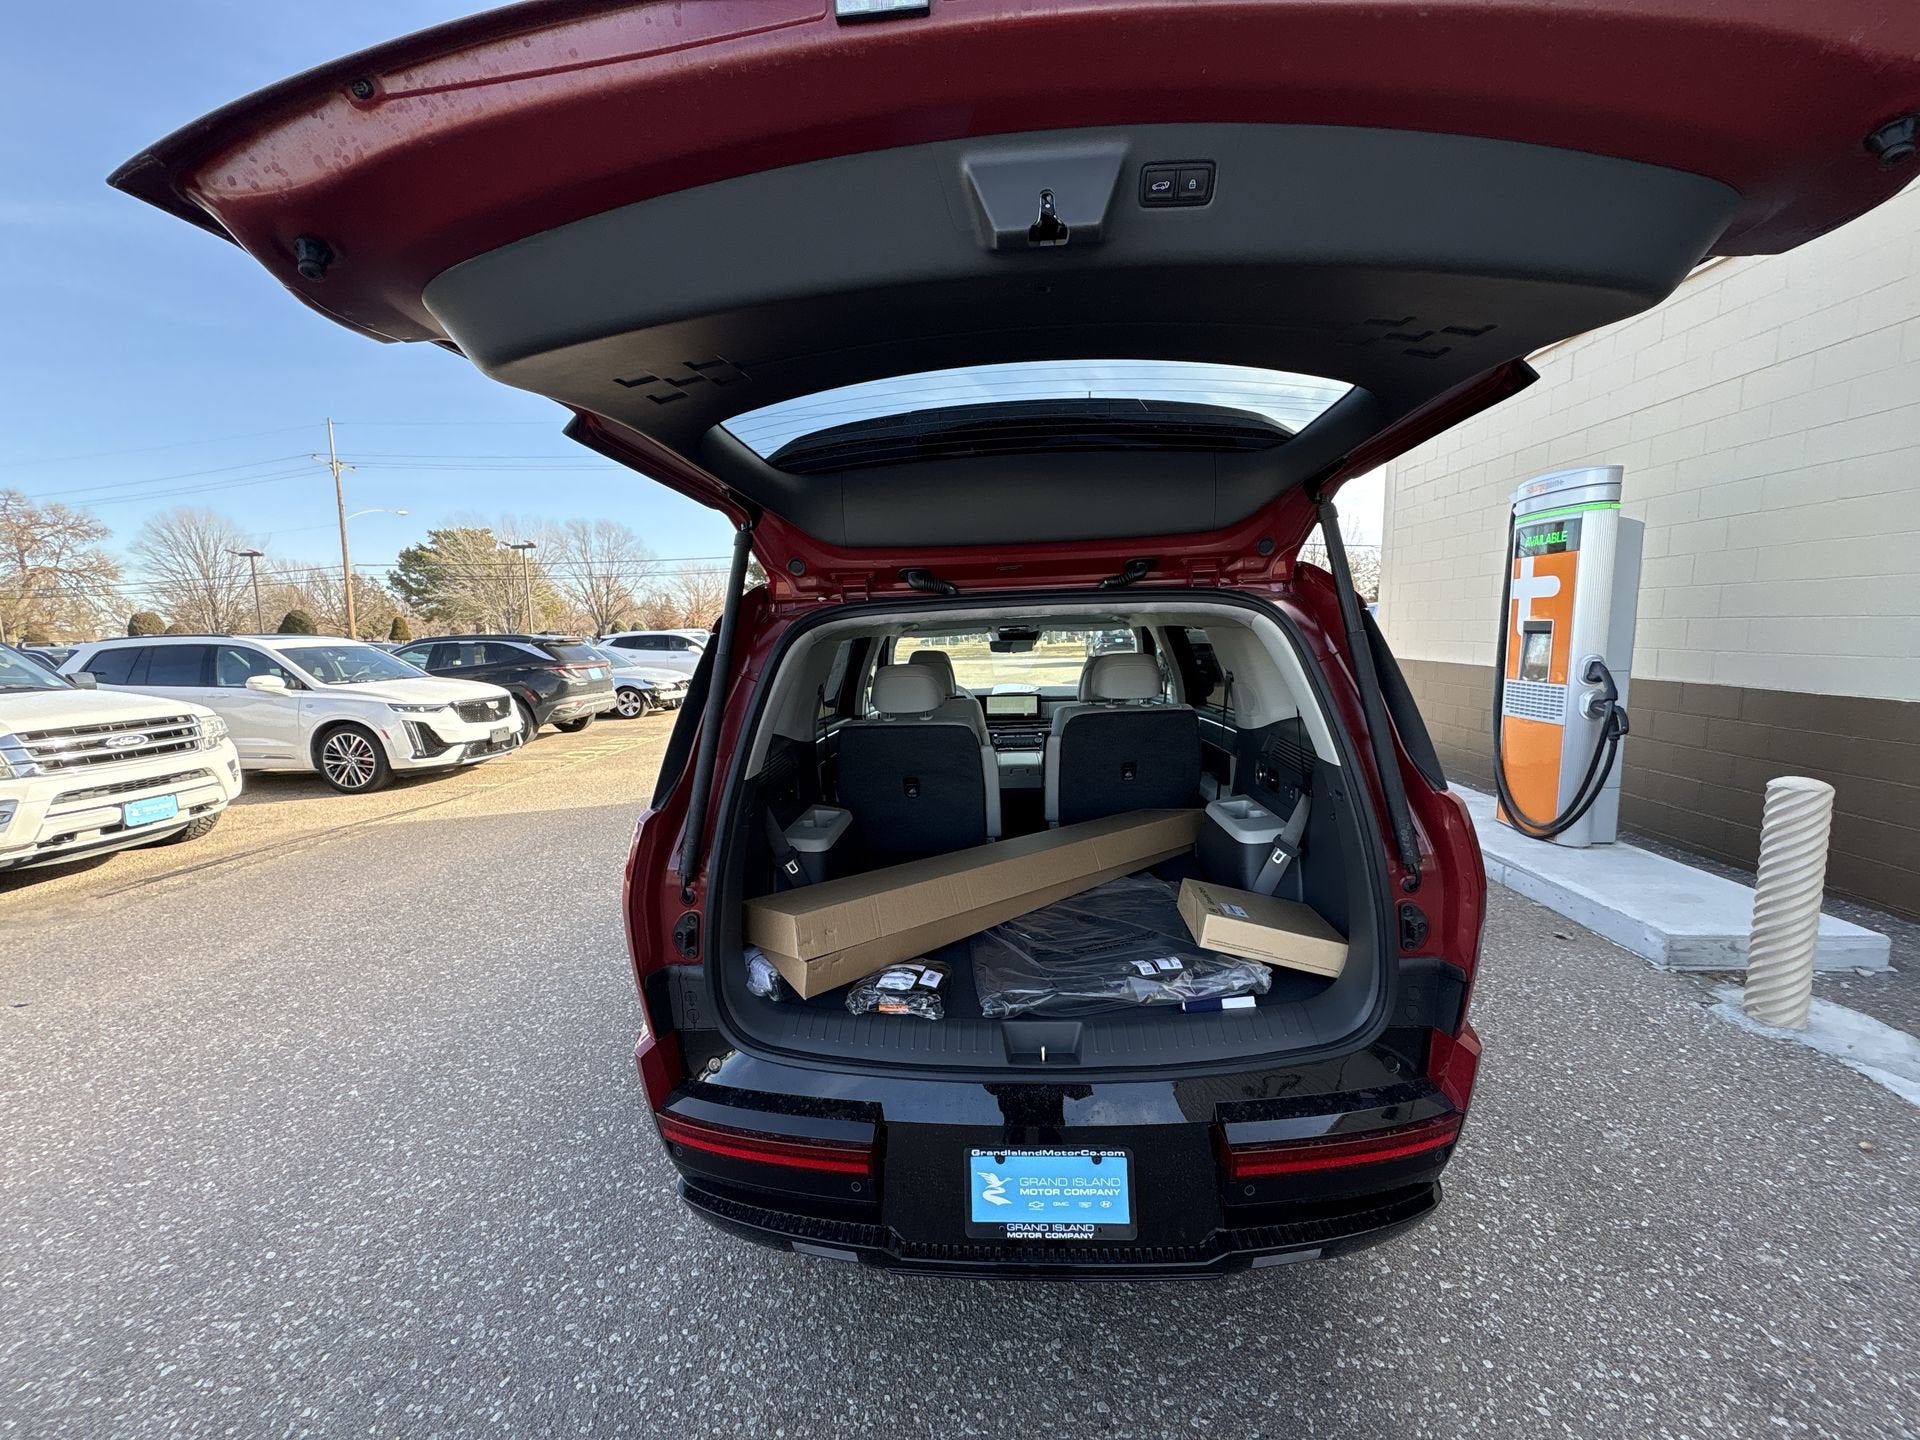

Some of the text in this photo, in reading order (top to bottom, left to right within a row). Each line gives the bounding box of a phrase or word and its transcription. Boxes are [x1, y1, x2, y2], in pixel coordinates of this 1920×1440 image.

[1525, 530, 1568, 548] AVAILABLE
[971, 1149, 1125, 1157] GrandIslandMotorCo.com
[1019, 1177, 1121, 1187] GRAND ISLAND
[1020, 1188, 1121, 1196] MOTOR COMPANY
[1006, 1223, 1095, 1232] GRAND ISLAND
